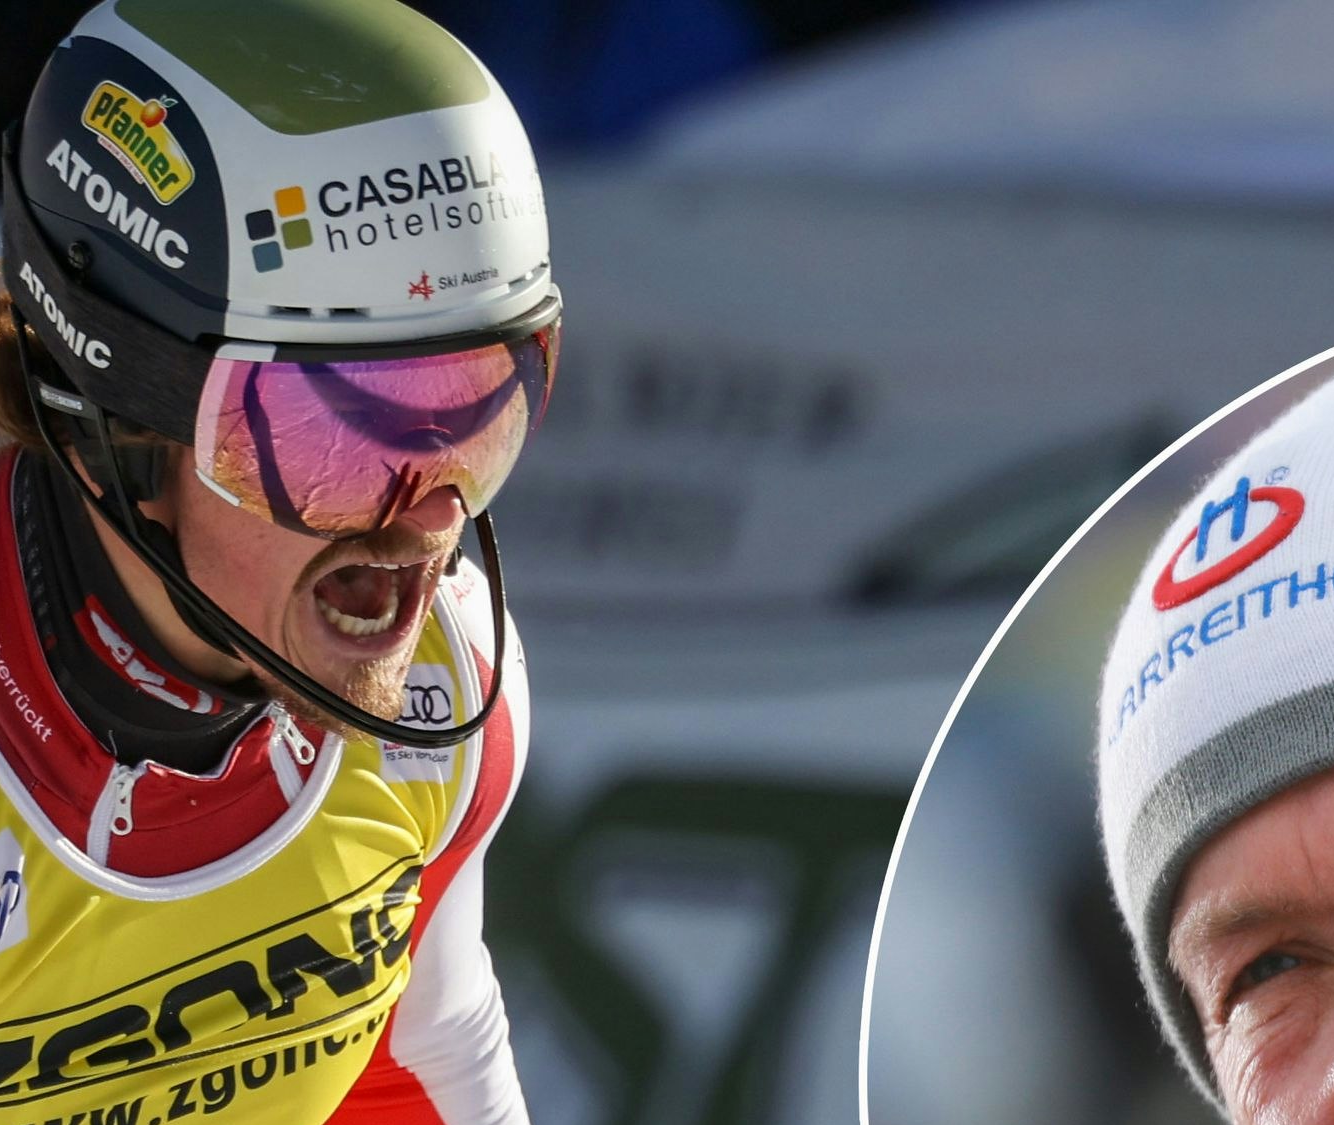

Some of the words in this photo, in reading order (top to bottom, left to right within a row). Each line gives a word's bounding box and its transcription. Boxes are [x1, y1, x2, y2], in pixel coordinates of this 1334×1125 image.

[90, 91, 180, 191] pfanner
[318, 151, 509, 218] CASABLA
[46, 139, 190, 269] ATOMIC
[19, 261, 113, 369] ATOMIC
[438, 274, 458, 290] Ski
[461, 266, 500, 284] Austria
